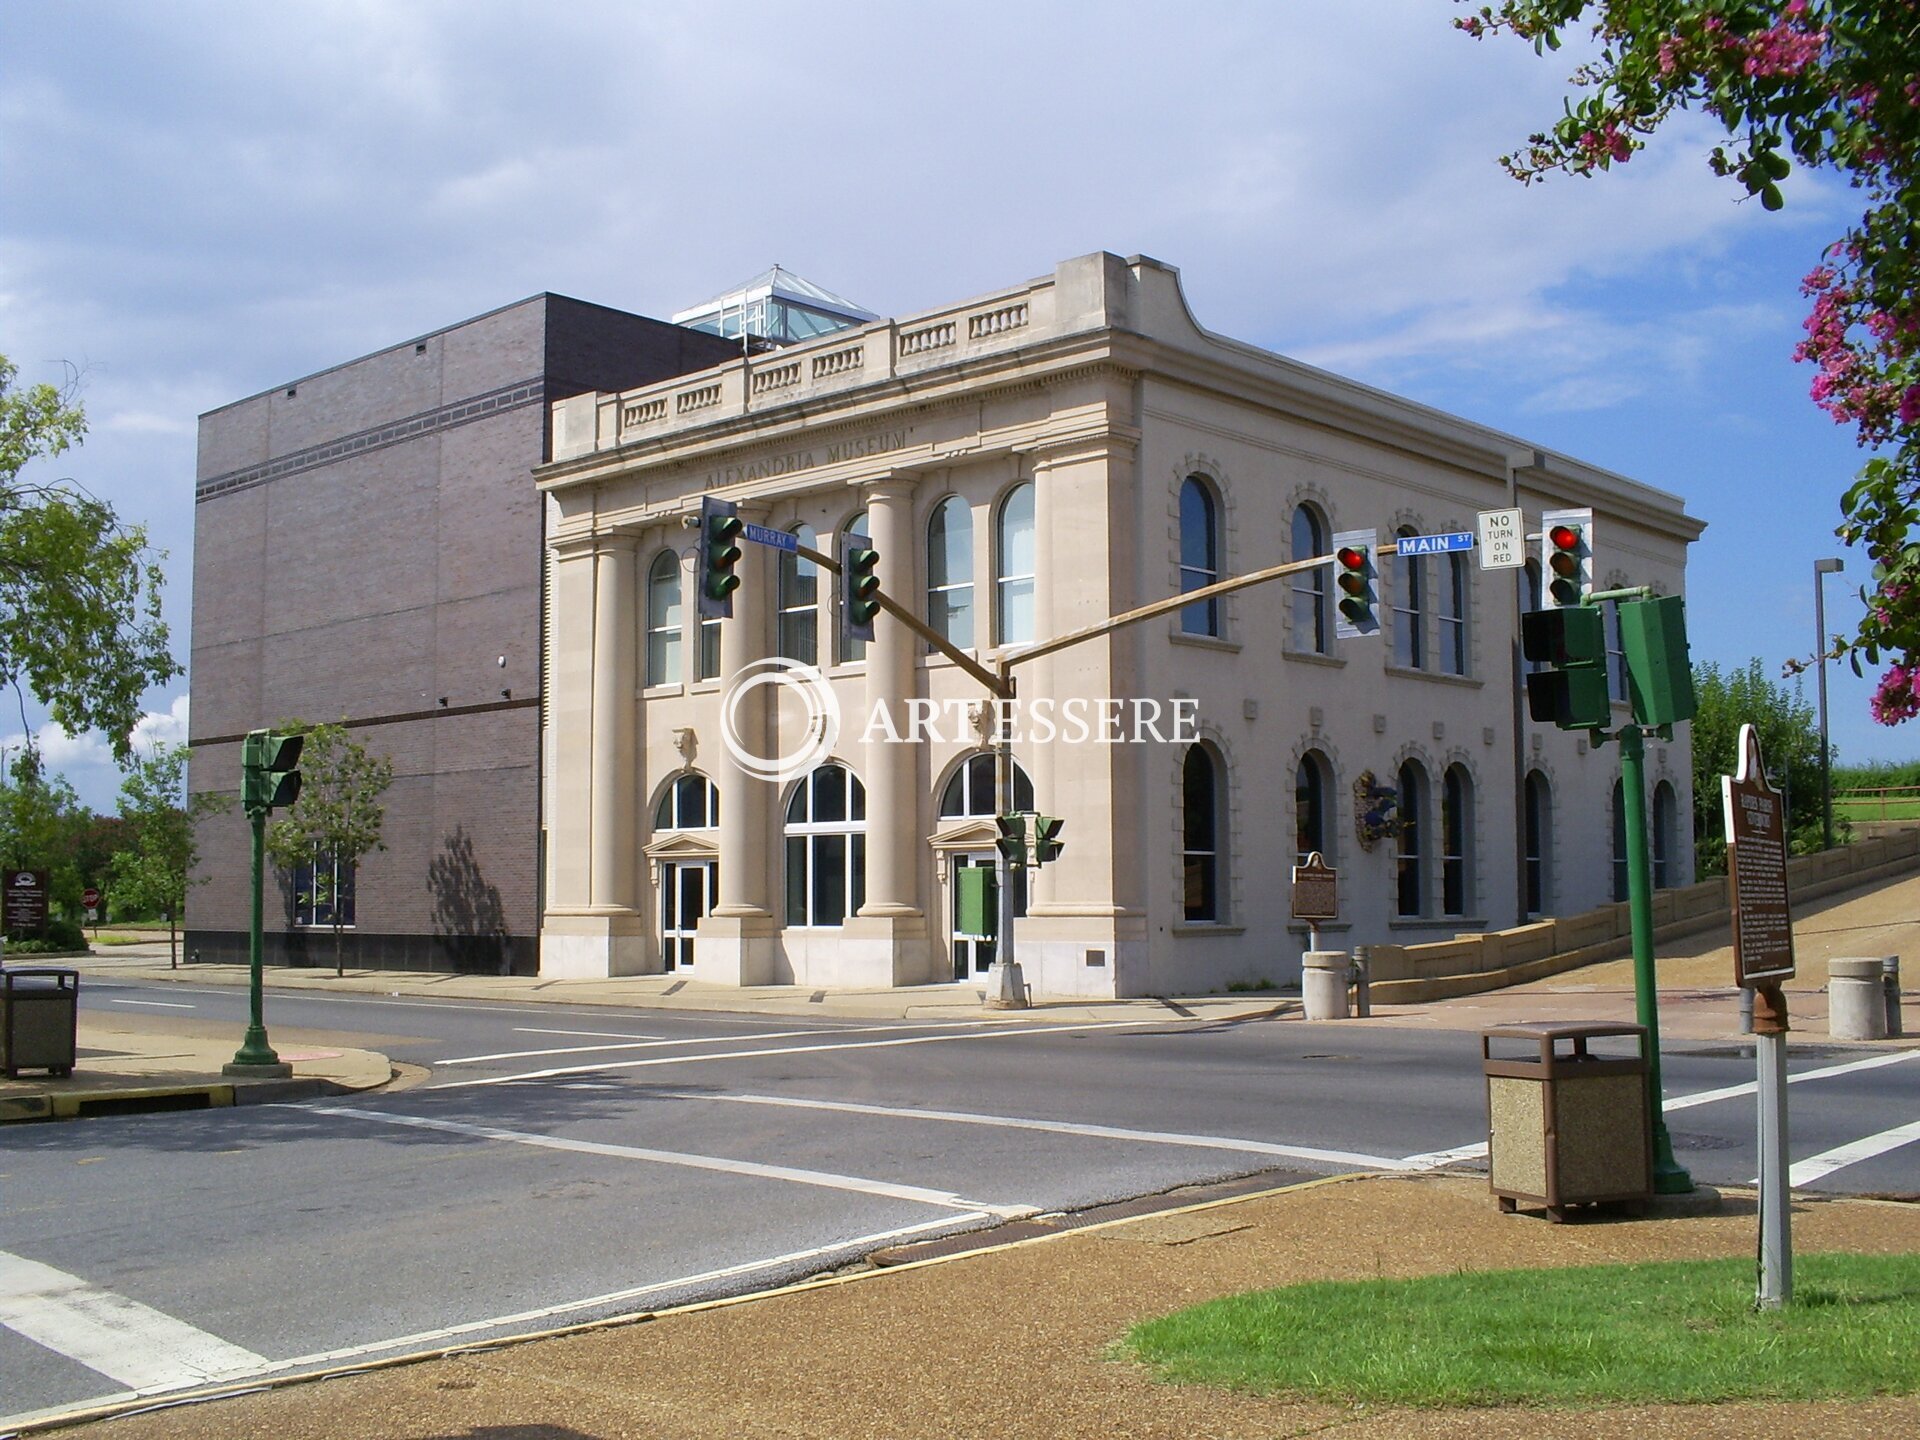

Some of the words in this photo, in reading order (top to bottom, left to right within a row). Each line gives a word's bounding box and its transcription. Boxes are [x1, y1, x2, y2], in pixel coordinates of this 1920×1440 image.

[704, 452, 815, 490] ALEXANDRIA
[828, 431, 906, 464] MUSEUM
[1490, 515, 1510, 528] NO
[749, 525, 787, 547] MURRAY
[1488, 529, 1513, 540] TURN
[1402, 537, 1449, 553] MAIN
[1458, 534, 1470, 543] ST
[1494, 542, 1509, 551] ON
[1493, 553, 1512, 563] RED
